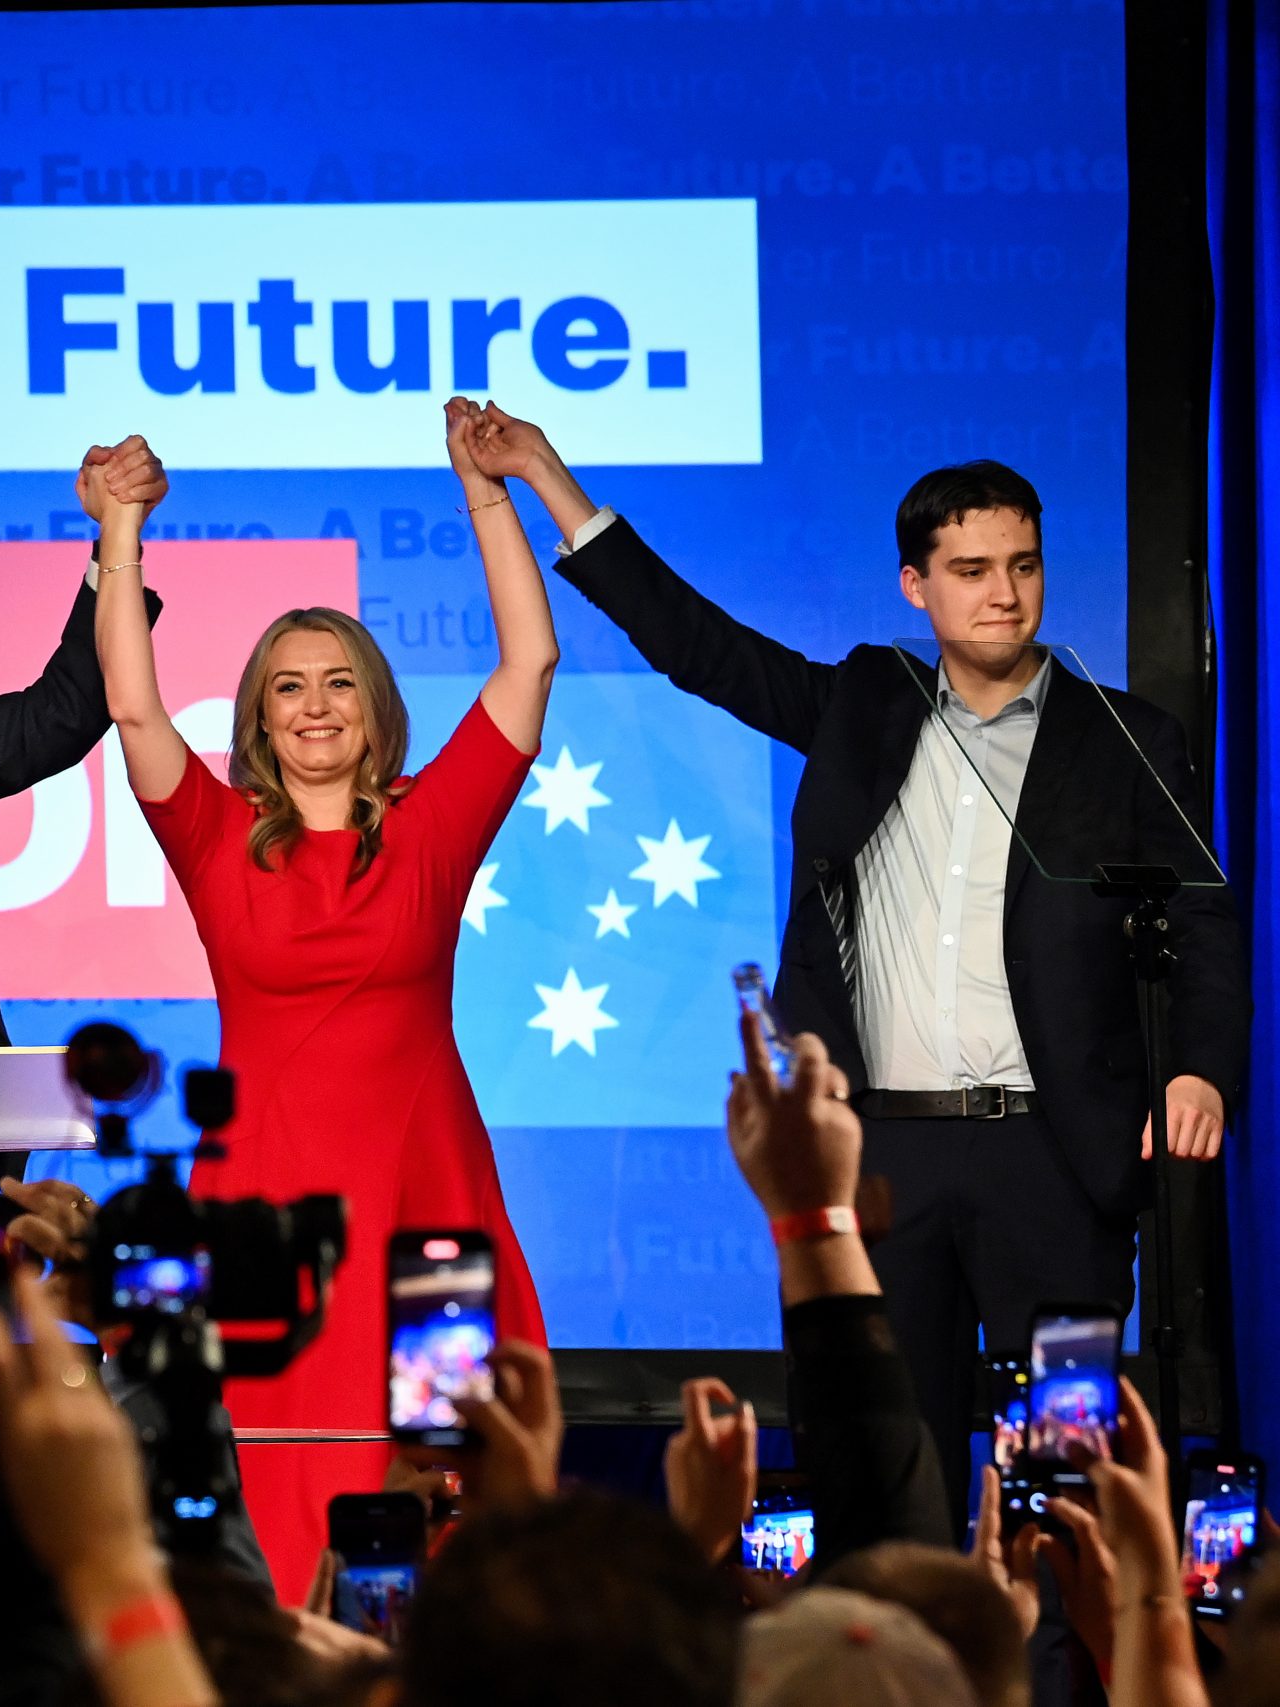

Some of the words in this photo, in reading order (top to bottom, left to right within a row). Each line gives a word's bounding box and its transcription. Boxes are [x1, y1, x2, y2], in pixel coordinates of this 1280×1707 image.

[38, 61, 254, 116] Future.
[787, 55, 830, 103] A
[848, 53, 1040, 104] Better
[40, 152, 289, 203] Future.
[306, 152, 360, 199] A
[872, 144, 927, 195] A
[859, 230, 1084, 284] Future.
[28, 269, 685, 394] Future.
[807, 322, 1064, 377] Future.
[790, 412, 838, 467] A
[855, 411, 1050, 465] Better
